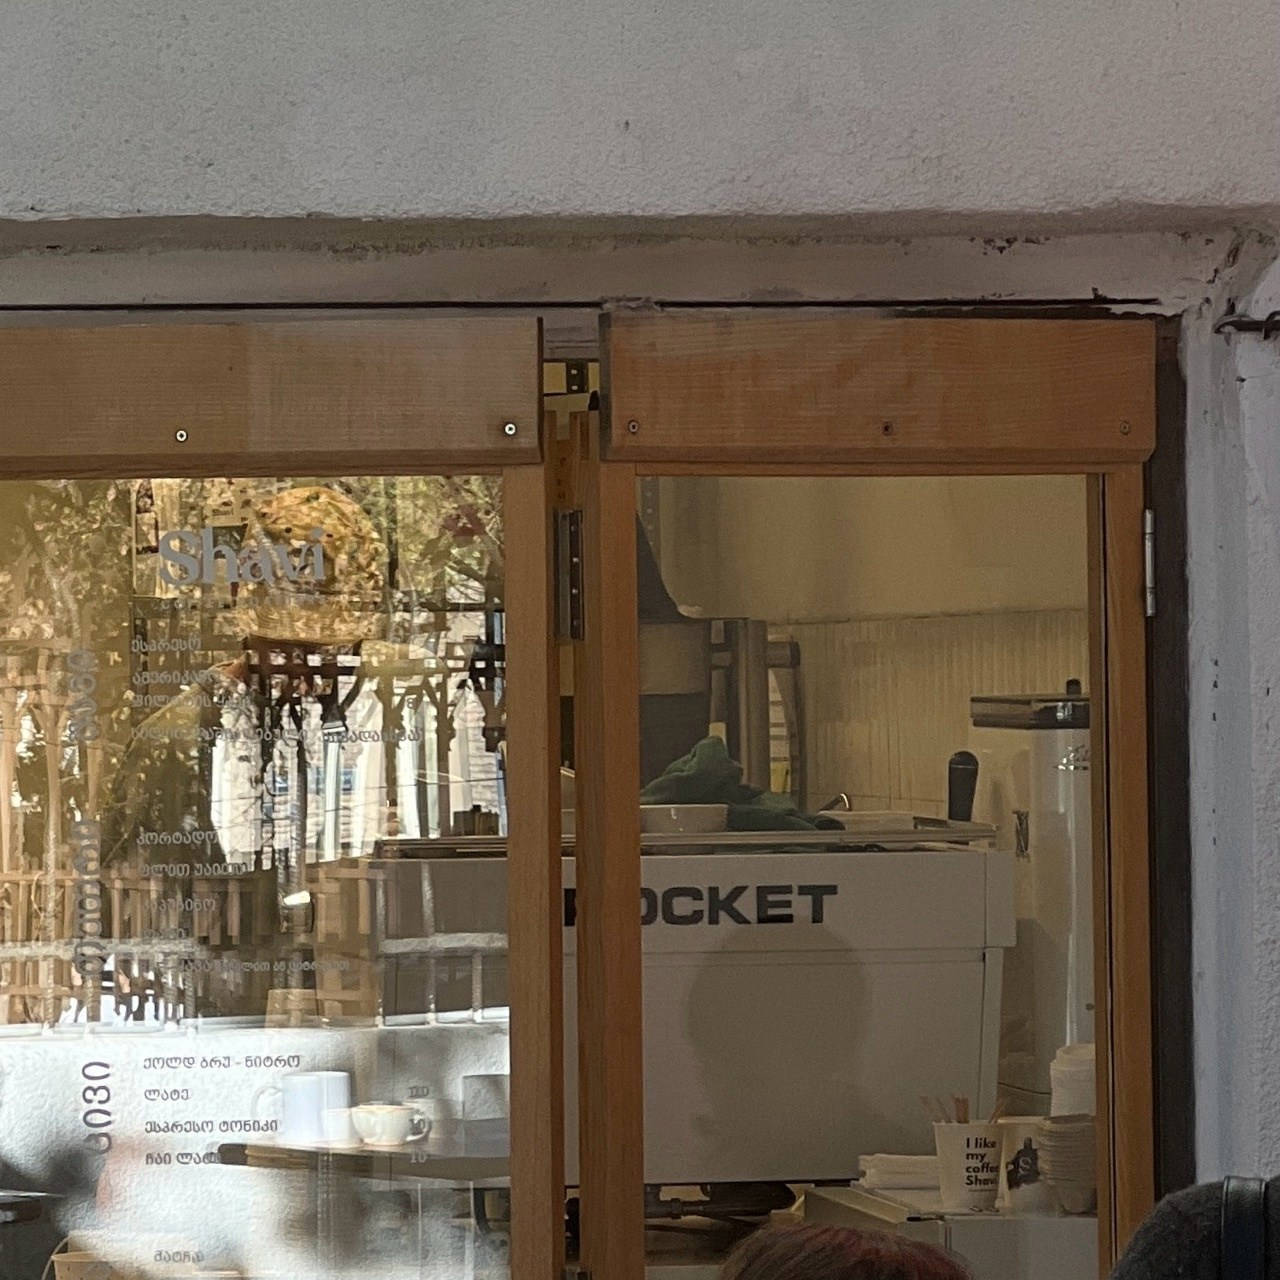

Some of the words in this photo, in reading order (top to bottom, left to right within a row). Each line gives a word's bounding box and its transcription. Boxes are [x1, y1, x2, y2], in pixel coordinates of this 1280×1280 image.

[159, 527, 326, 587] Shavi
[564, 885, 838, 926] CKET
[144, 1056, 195, 1069] ქოლდ
[200, 1056, 231, 1069] ბრუ
[245, 1055, 300, 1068] ნიტრო
[144, 1088, 190, 1101] ლატე
[81, 1061, 112, 1155] ცივი
[145, 1120, 214, 1133] ესპრესო
[219, 1119, 279, 1133] ტონიკი
[975, 1137, 997, 1149] like
[145, 1152, 172, 1165] ჩაი
[965, 1152, 987, 1163] my
